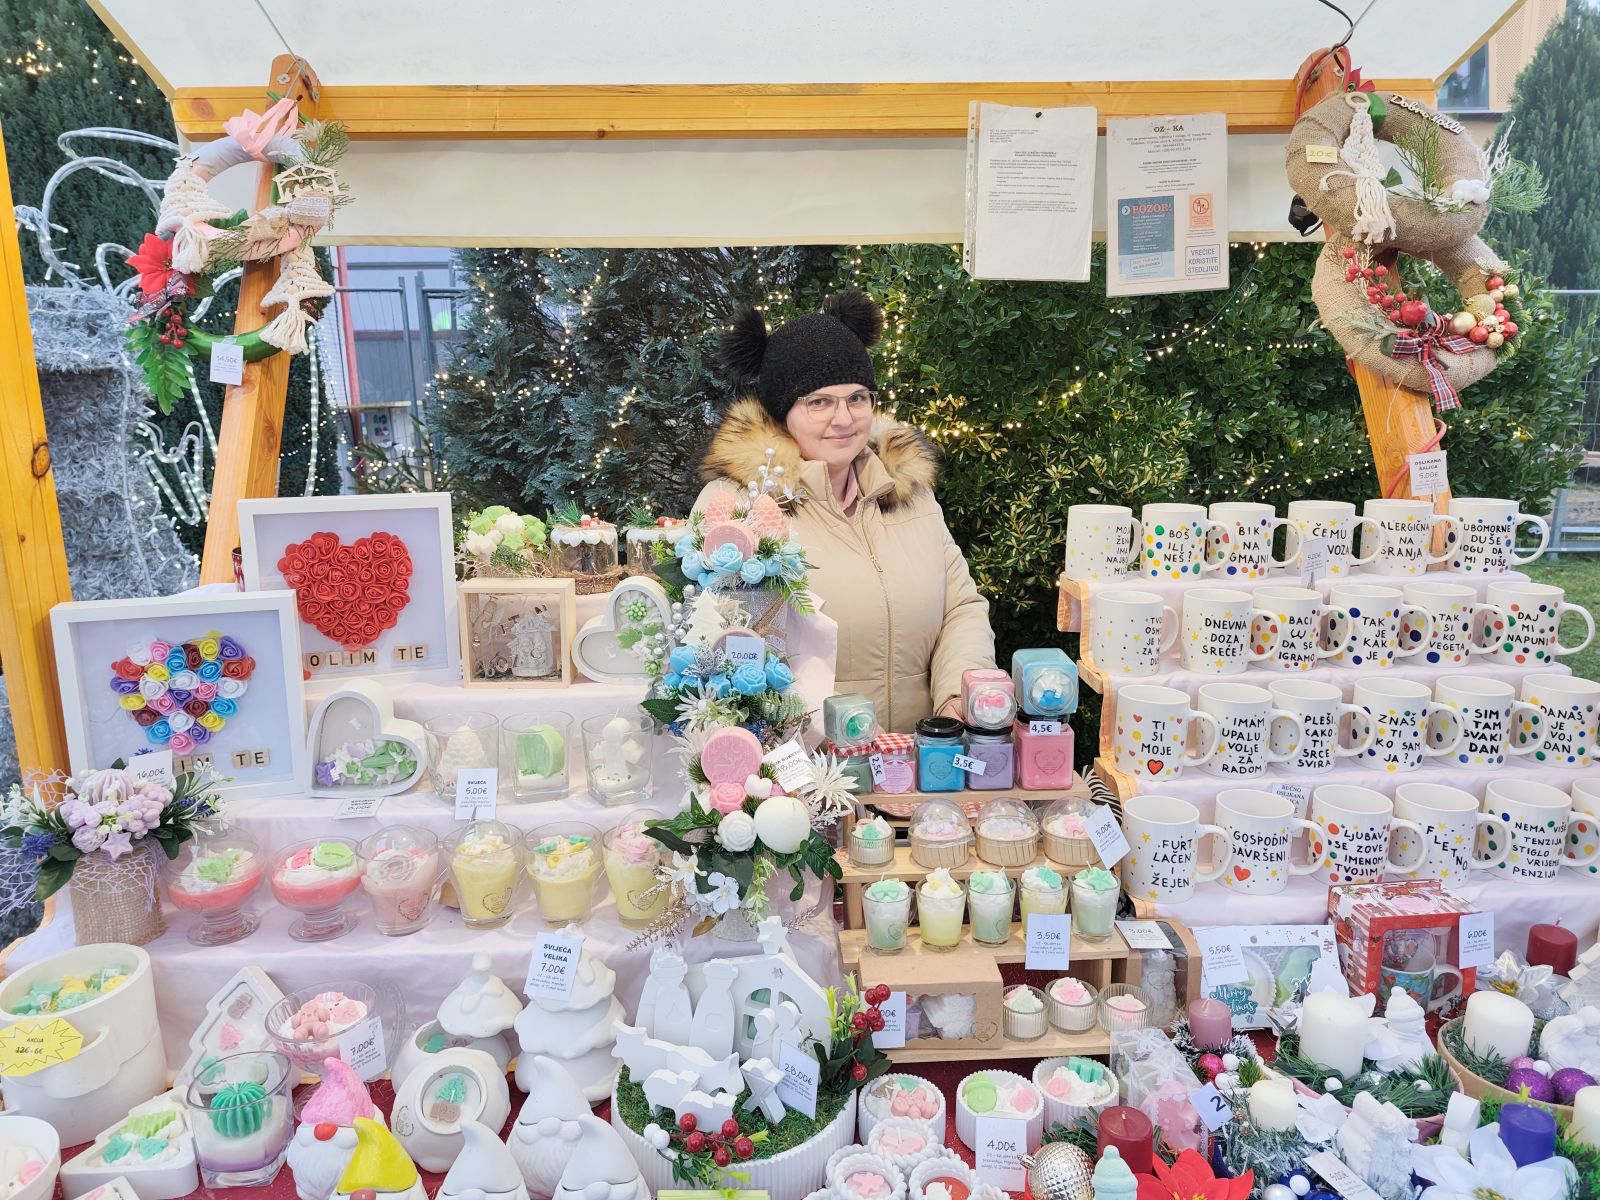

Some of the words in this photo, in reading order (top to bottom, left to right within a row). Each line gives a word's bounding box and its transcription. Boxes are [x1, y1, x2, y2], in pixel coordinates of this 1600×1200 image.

[1188, 257, 1218, 266] KORISTITE
[1238, 526, 1260, 536] BIK
[1312, 522, 1347, 540] ČEMU
[1380, 520, 1430, 532] ALERGIČNA
[1463, 524, 1512, 534] UBOMORNE
[1169, 528, 1190, 540] BOŠ
[1471, 533, 1502, 546] DUŠE
[1168, 542, 1184, 552] ILI
[1243, 542, 1260, 550] NA
[1460, 544, 1484, 554] OGU
[1230, 553, 1268, 564] GMAJNI
[1380, 546, 1422, 561] SRANJA
[1464, 556, 1476, 564] MI
[1484, 556, 1507, 567] PUŠE
[1289, 616, 1312, 626] BACI
[1362, 616, 1385, 627] TAK
[1438, 613, 1460, 622] TAK
[1518, 612, 1539, 622] DAJ
[1204, 618, 1246, 631] DNEVNA
[1444, 624, 1454, 632] SI
[1522, 624, 1534, 632] MI
[1210, 634, 1239, 644] DOZA
[1375, 629, 1386, 638] JE
[1443, 633, 1455, 641] KO
[1146, 638, 1154, 646] JE
[1282, 640, 1296, 649] DA
[1304, 642, 1312, 650] SE
[1363, 638, 1387, 648] KAK
[1507, 634, 1548, 646] NAPUNI
[1142, 648, 1152, 656] ZA
[1429, 641, 1464, 652] VEGETA
[310, 652, 375, 666] OLIM
[398, 647, 424, 660] TE
[1278, 652, 1316, 662] IGRAMO
[1366, 652, 1378, 660] JE
[1304, 713, 1334, 726] PLEŠI
[1378, 712, 1416, 726] ZNAŠ
[1474, 709, 1500, 720] SIM
[1152, 720, 1165, 730] TI
[1233, 717, 1264, 728] IMAM
[1473, 720, 1502, 730] TAM
[1550, 721, 1565, 730] JE
[1032, 724, 1052, 733] 4,5€
[1391, 729, 1402, 738] TI
[1152, 732, 1162, 742] SI
[1222, 728, 1260, 741] UPALU
[1464, 729, 1502, 742] SVAKI
[1550, 731, 1572, 742] VOJ
[1141, 743, 1172, 756] MOJE
[1228, 742, 1259, 756] VOLJE
[1312, 740, 1322, 748] TI
[1376, 738, 1394, 748] KO
[1402, 742, 1421, 752] SAM
[1468, 742, 1499, 754] DAN
[1544, 741, 1571, 754] DAN
[236, 752, 264, 766] TE
[1302, 748, 1330, 759] SRCE
[1384, 754, 1399, 763] JA
[954, 756, 974, 770] 3,5€
[1238, 756, 1252, 764] ZA
[1297, 759, 1331, 768] SVIRA
[874, 756, 884, 776] 2,5€
[1222, 764, 1262, 774] RADOM
[1515, 822, 1546, 833] NEMA
[1234, 830, 1288, 846] GOSPODIN
[1344, 829, 1384, 842] LJUBAV
[1524, 836, 1562, 846] TENZIJA
[1162, 840, 1192, 850] FURT
[1334, 841, 1348, 850] SE
[1356, 844, 1382, 854] ZOVE
[1512, 845, 1550, 858] STIGLO
[1152, 852, 1192, 864] LAČEN
[1344, 854, 1383, 866] IMENOM
[1526, 858, 1560, 866] VRIJEME
[1335, 864, 1378, 876] TVOJIM
[1512, 866, 1556, 878] PENZIJA
[1151, 873, 1190, 888] ŽEJEN
[1036, 932, 1061, 940] 3,50€
[543, 952, 568, 962] VELIKA
[1210, 1096, 1226, 1112] 2
[988, 1140, 1016, 1152] 4,00€
